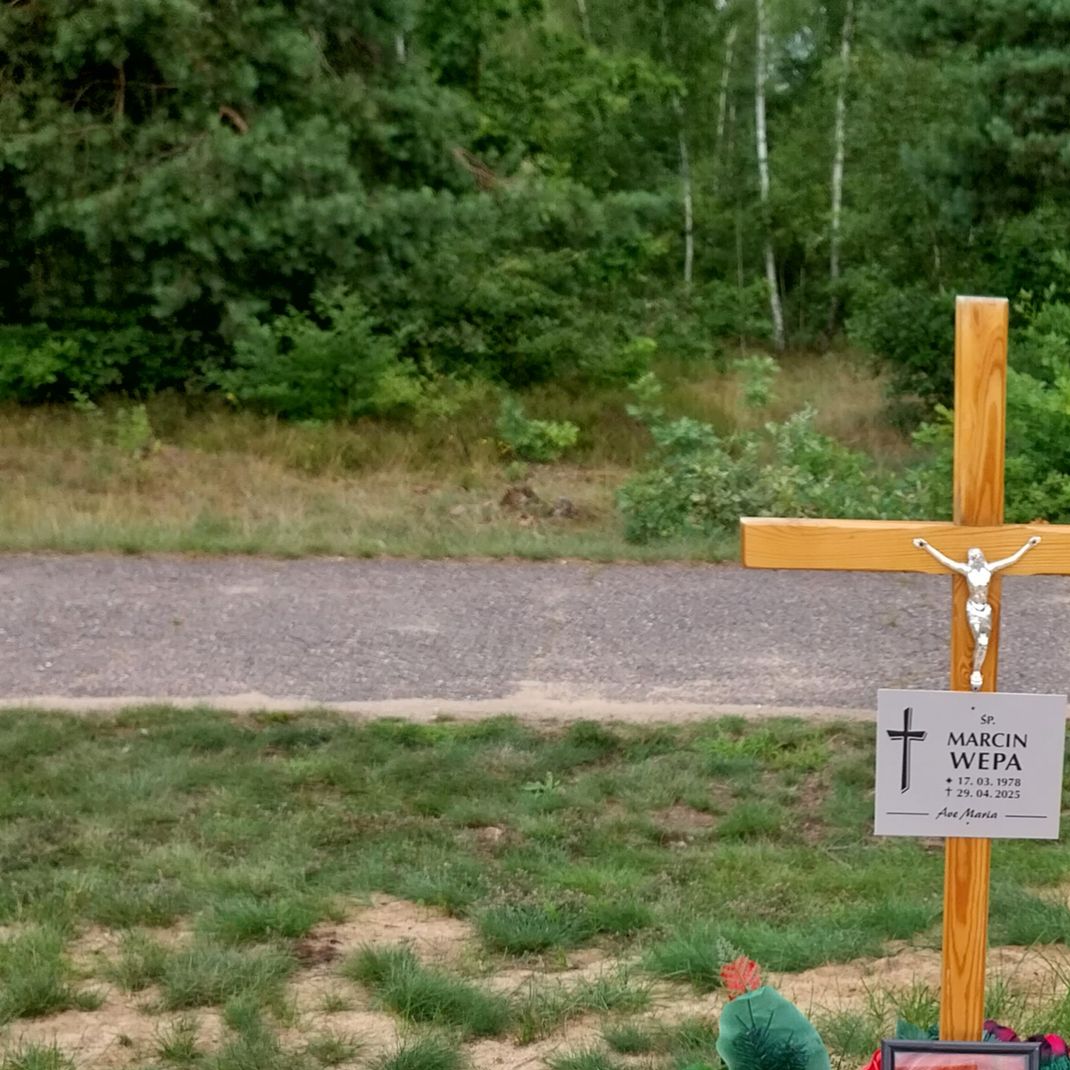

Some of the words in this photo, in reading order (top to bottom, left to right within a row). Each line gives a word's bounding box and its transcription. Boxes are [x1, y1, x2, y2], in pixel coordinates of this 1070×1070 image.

[947, 731, 1028, 748] MARCIN
[950, 751, 1022, 771] WEPA
[958, 776, 974, 786] 17.
[976, 777, 993, 787] 03.
[996, 777, 1021, 787] 1978
[956, 788, 973, 798] 29.
[976, 789, 993, 799] 04.
[995, 789, 1020, 799] 2025
[935, 806, 958, 820] Ave
[959, 807, 998, 820] Maria
